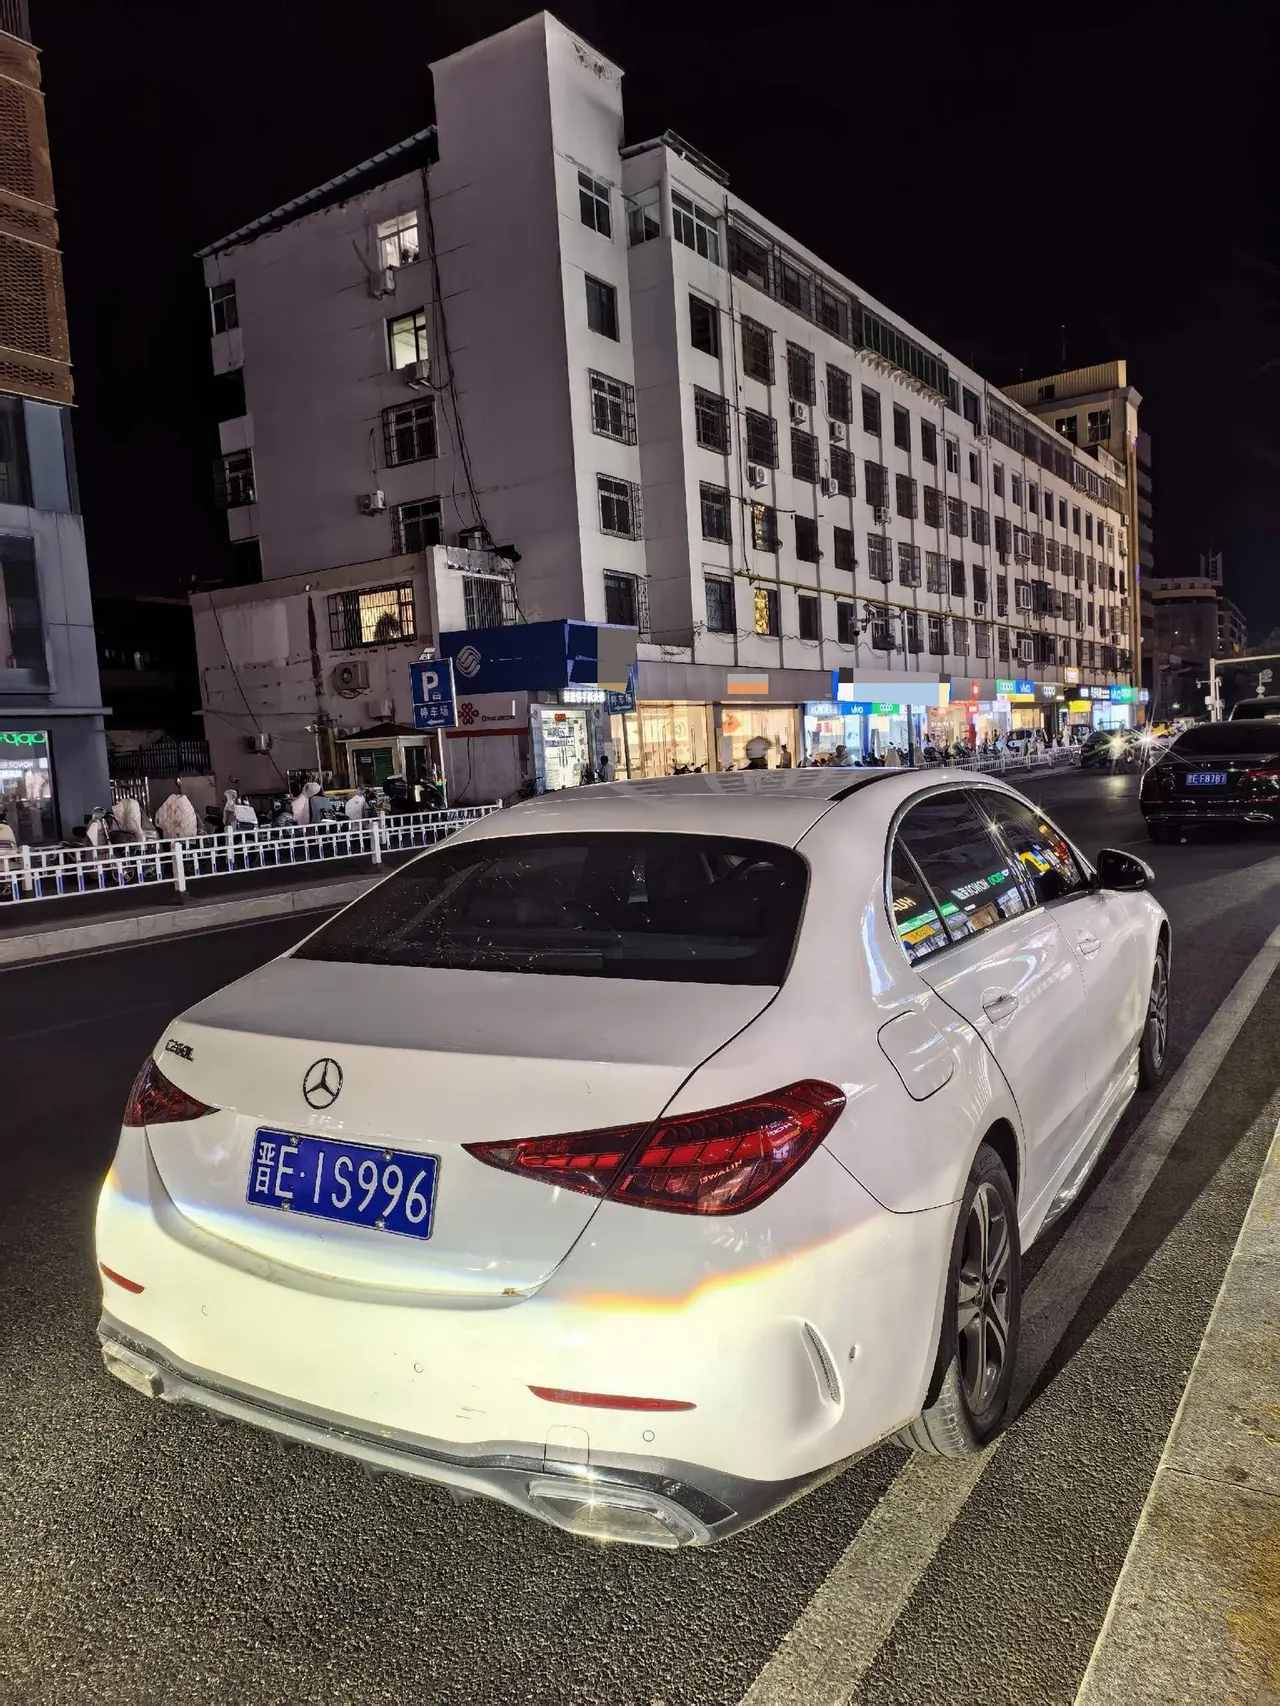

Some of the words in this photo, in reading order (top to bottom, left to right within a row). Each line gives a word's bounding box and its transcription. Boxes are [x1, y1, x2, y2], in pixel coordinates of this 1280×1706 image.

[421, 671, 439, 702] P
[420, 705, 449, 719] 停车场
